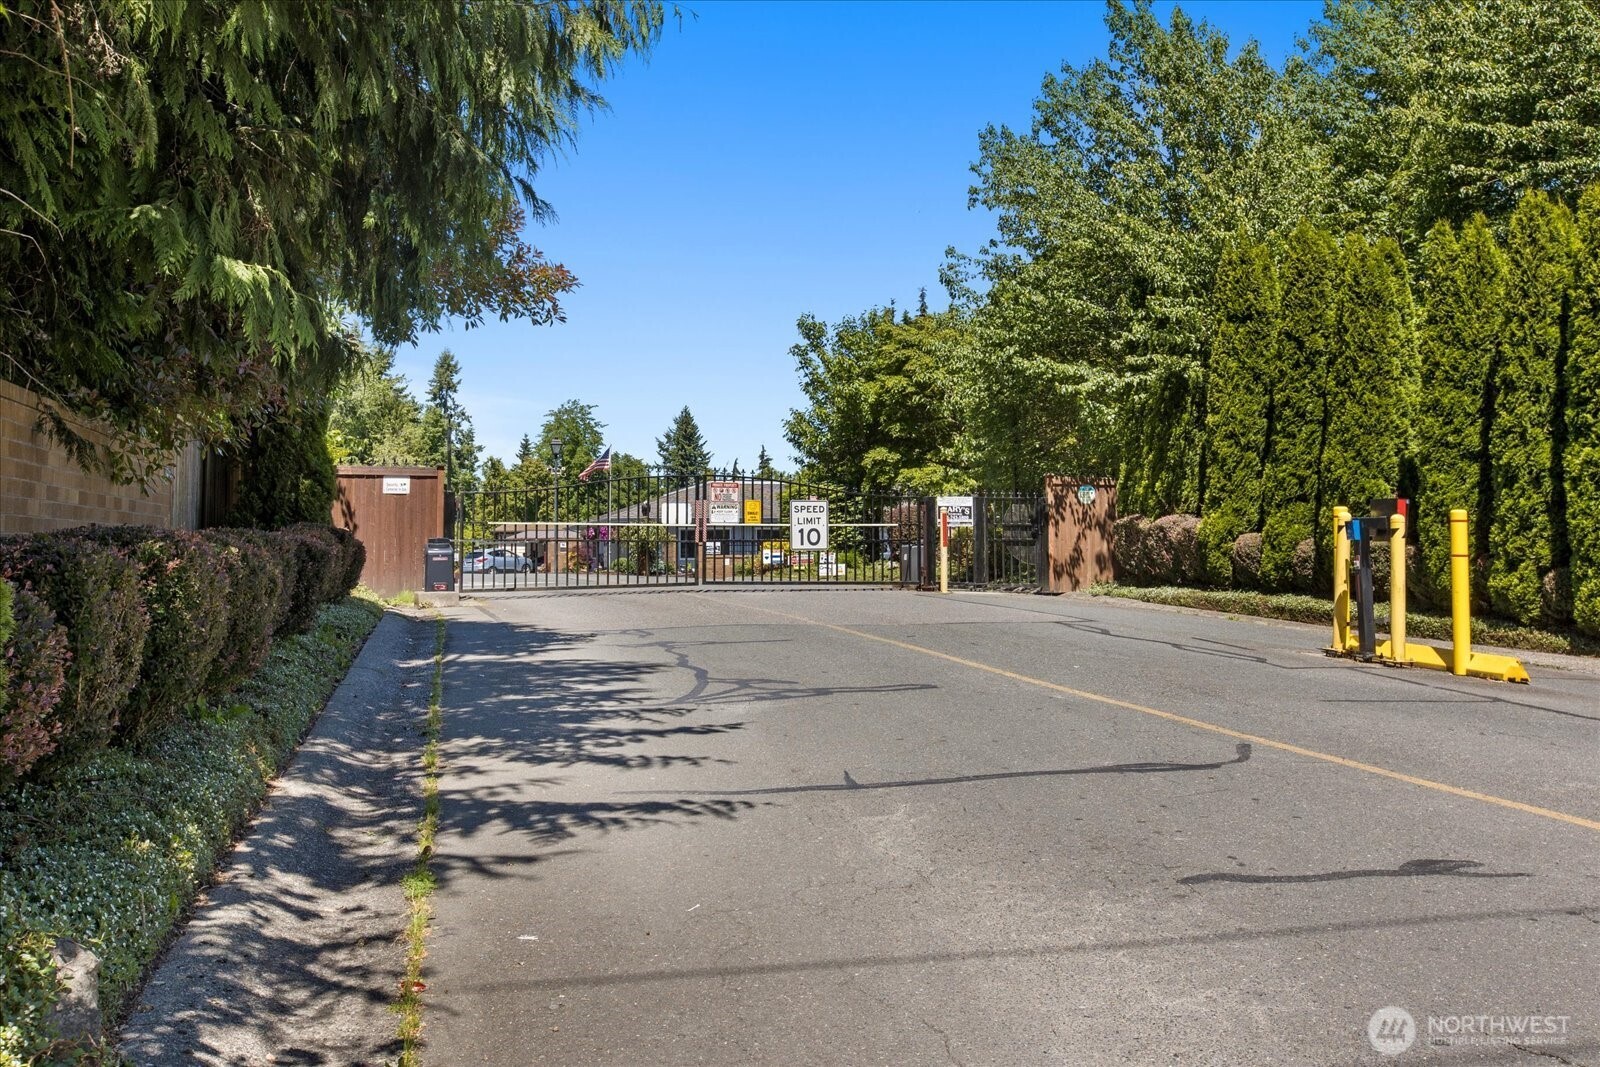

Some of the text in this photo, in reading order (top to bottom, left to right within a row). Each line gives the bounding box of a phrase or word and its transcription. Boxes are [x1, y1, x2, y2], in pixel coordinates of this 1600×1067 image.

[794, 505, 825, 513] SPEED
[946, 506, 970, 515] ARY'S
[797, 517, 821, 525] LIMIT
[798, 528, 821, 546] 10
